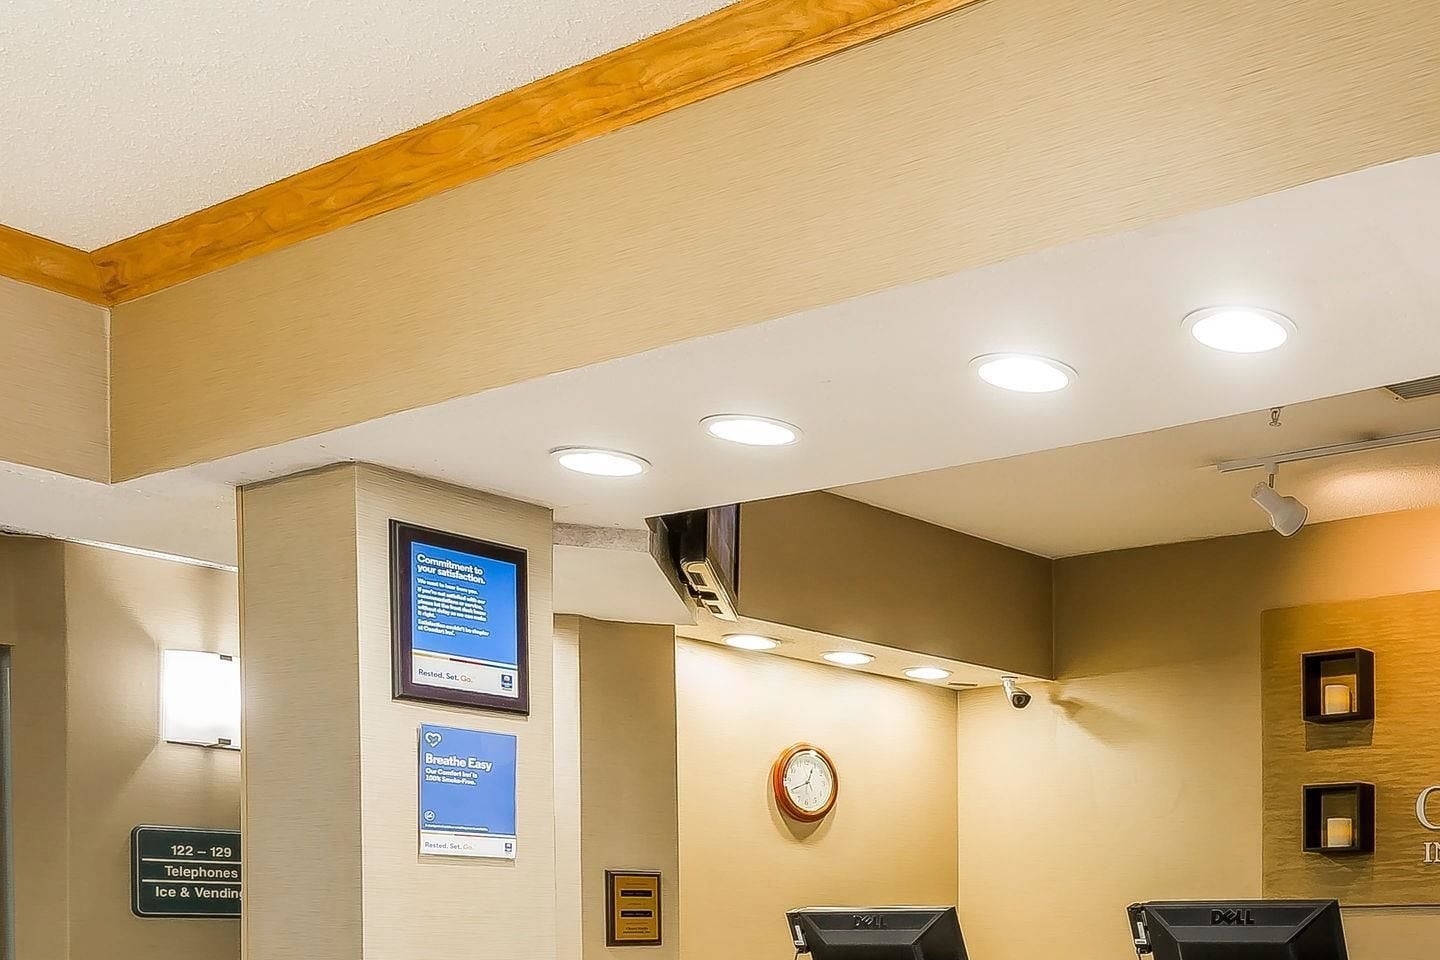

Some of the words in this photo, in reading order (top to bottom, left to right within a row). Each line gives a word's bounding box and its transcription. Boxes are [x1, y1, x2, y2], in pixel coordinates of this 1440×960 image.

[417, 554, 473, 573] Commitment
[474, 566, 484, 575] to
[417, 565, 436, 574] your
[437, 569, 486, 584] satisfaction.
[418, 668, 444, 679] Rested.
[446, 673, 459, 681] Set.
[425, 752, 466, 767] Breathe
[467, 757, 493, 771] Easy
[171, 845, 193, 856] 122
[210, 847, 232, 857] 129
[164, 865, 238, 879] Telephones
[155, 886, 176, 897] Ice
[180, 887, 190, 898] &
[1210, 909, 1255, 925] DELL
